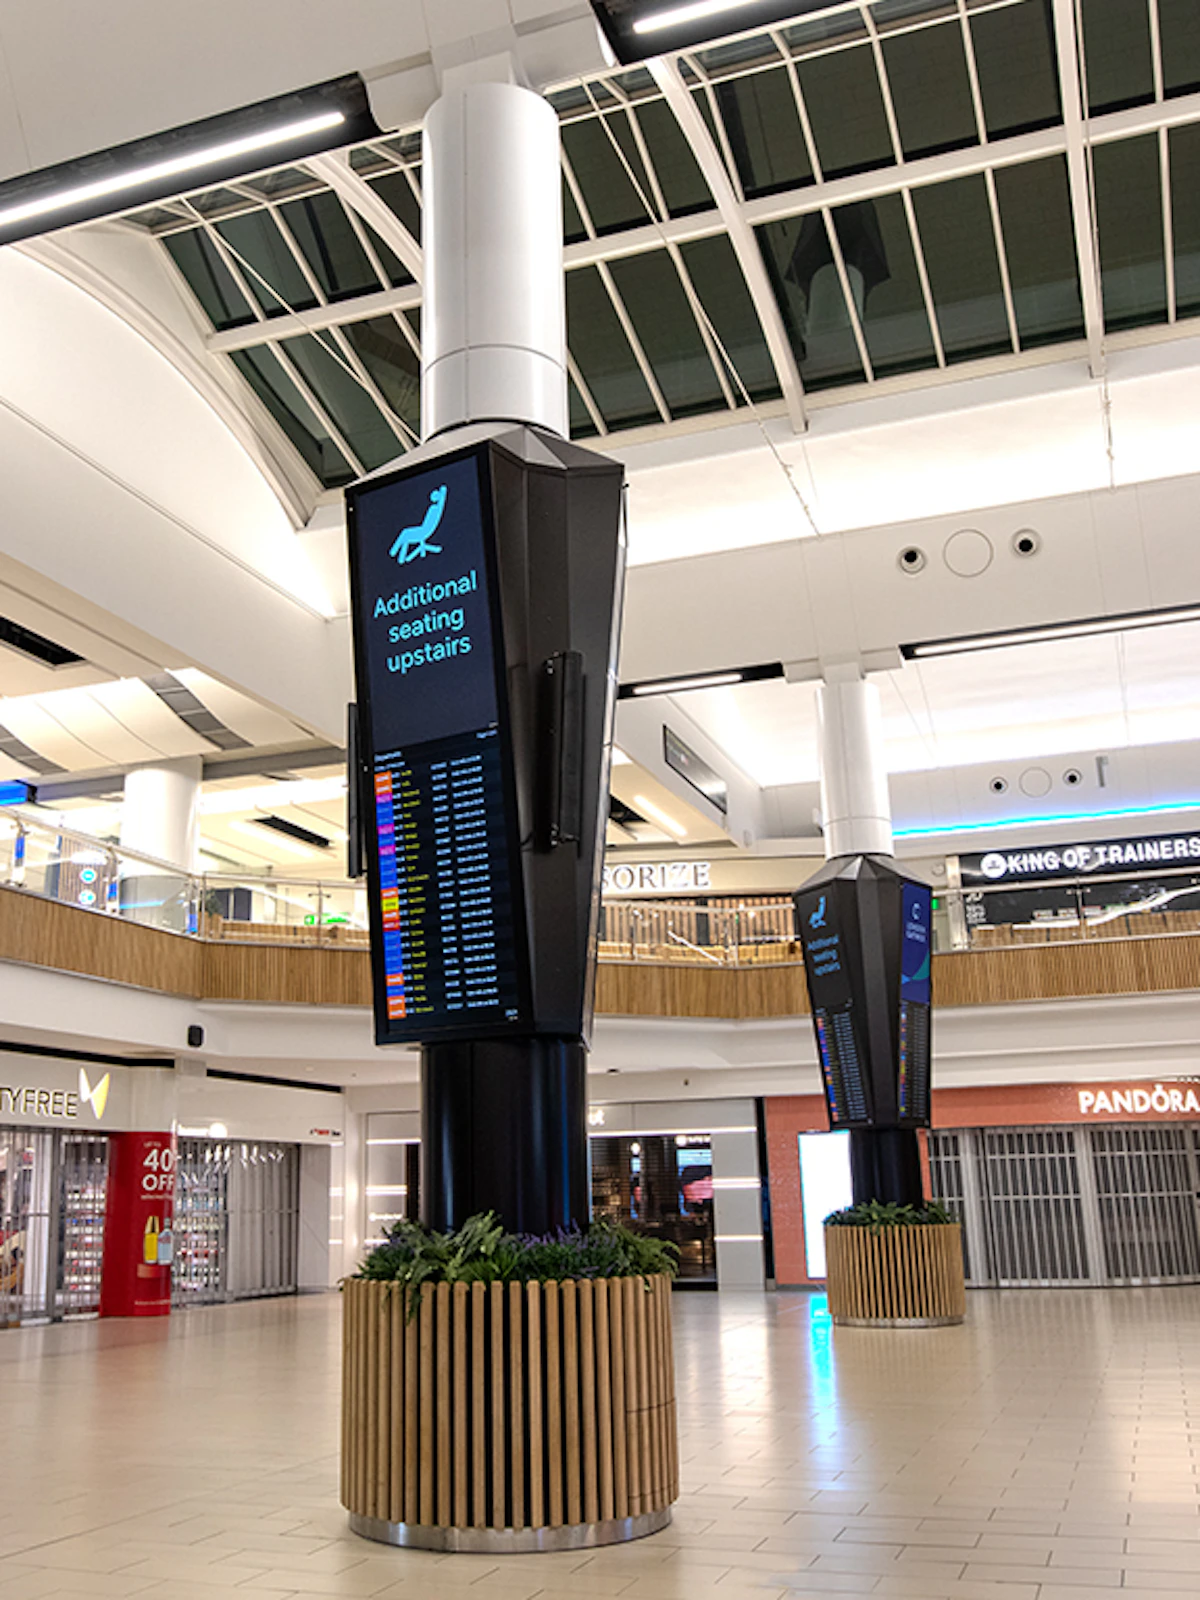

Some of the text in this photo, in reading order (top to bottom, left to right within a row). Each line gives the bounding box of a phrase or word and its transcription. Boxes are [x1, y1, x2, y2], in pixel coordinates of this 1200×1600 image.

[373, 569, 478, 619] Additional
[388, 606, 465, 644] seating
[386, 635, 472, 675] upstairs
[1007, 851, 1060, 874] KING
[1063, 847, 1091, 869] OF
[1095, 837, 1200, 866] TRAINERS
[1078, 1084, 1200, 1114] PANDORA
[143, 1148, 176, 1172] 40
[142, 1173, 175, 1191] OFF
